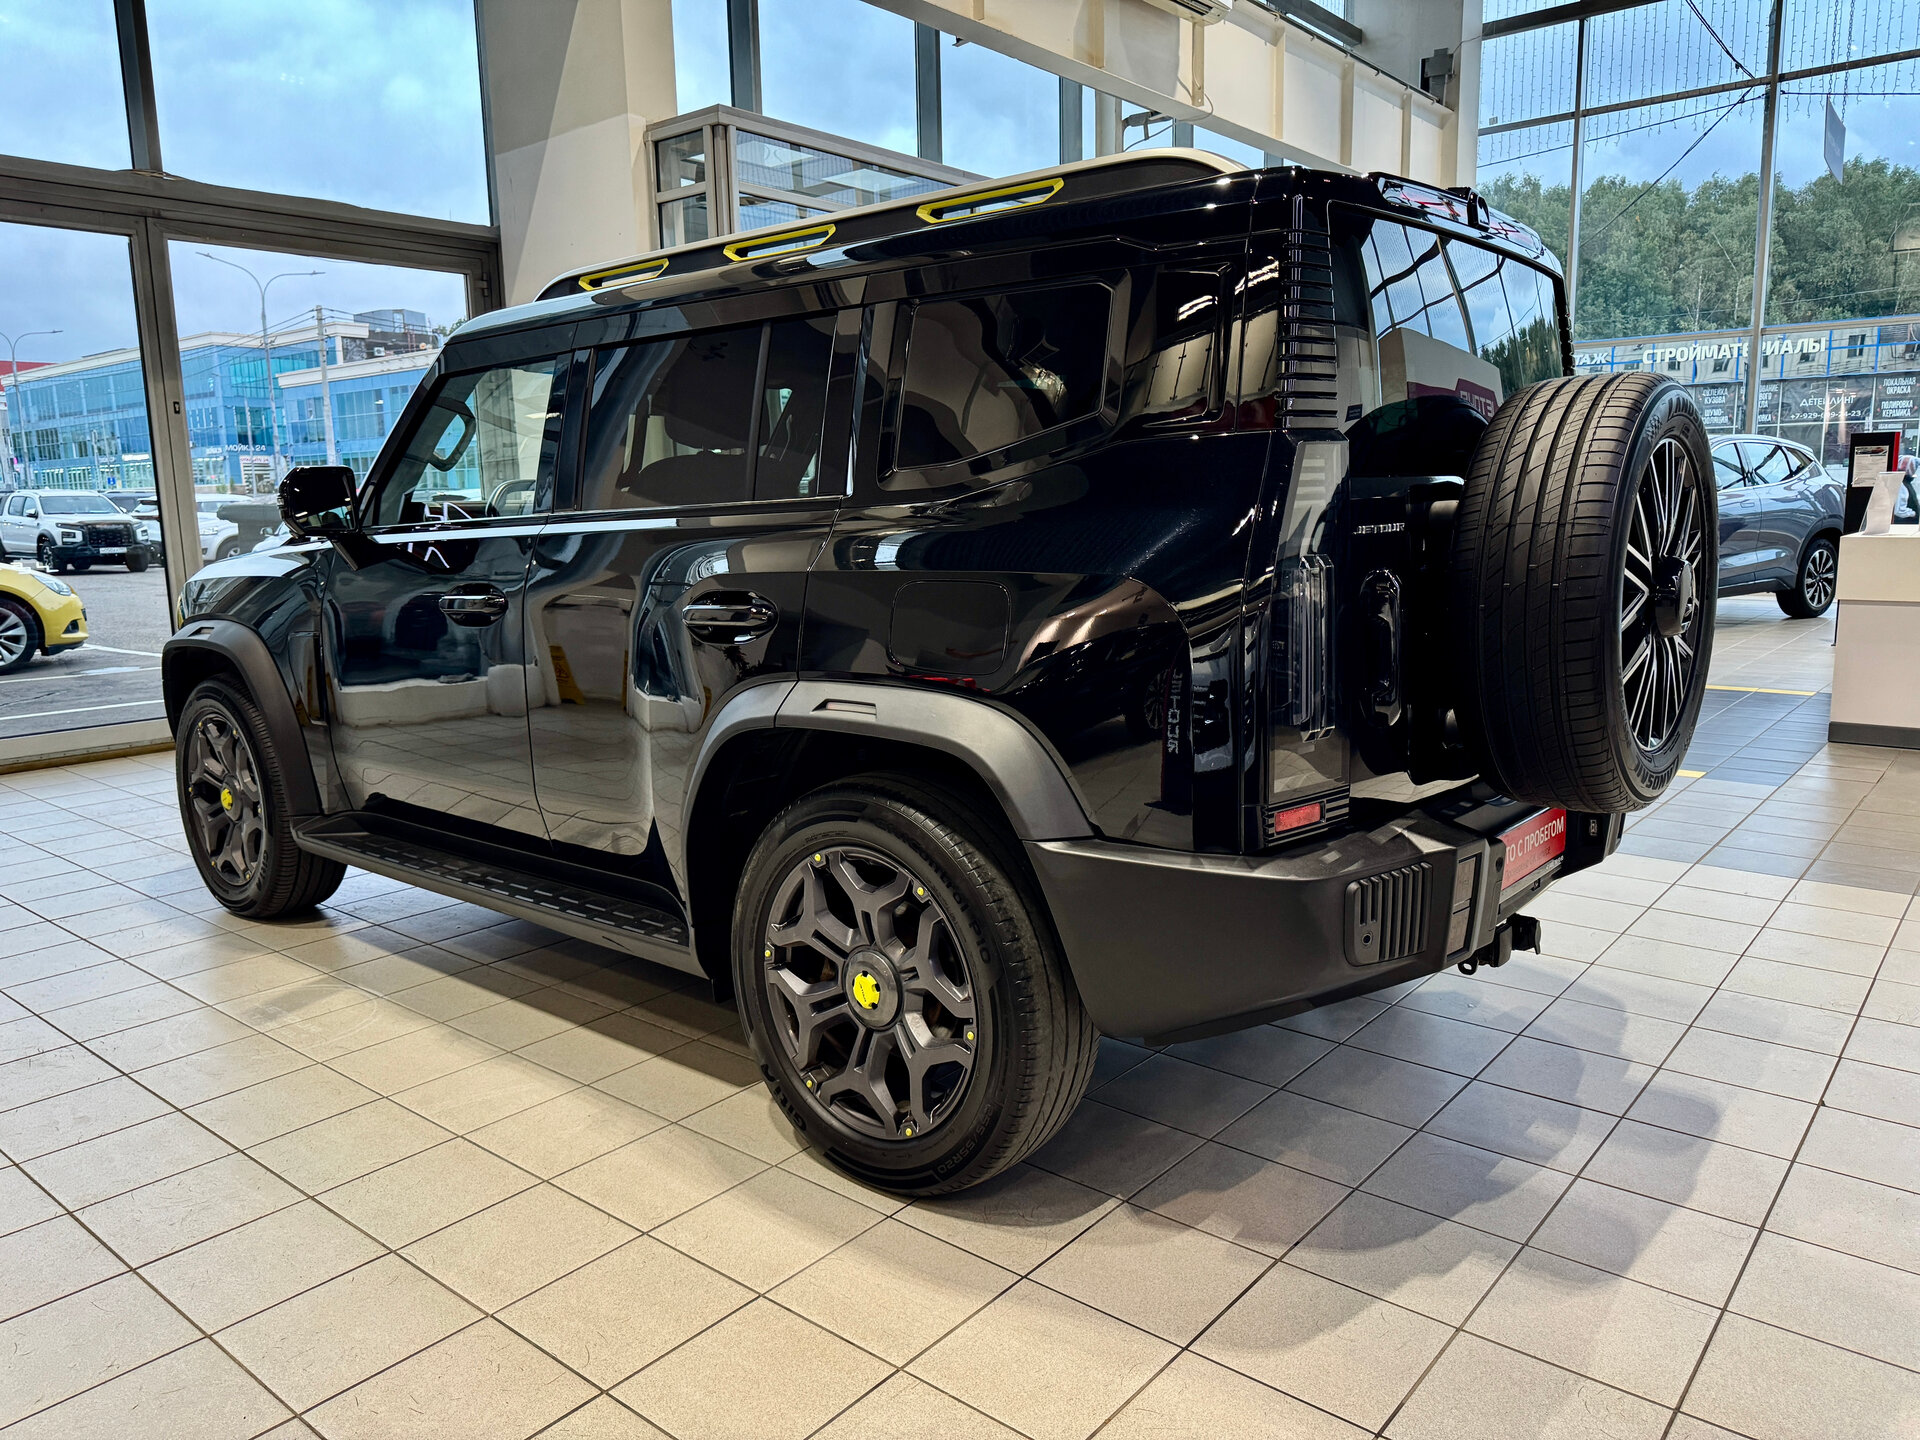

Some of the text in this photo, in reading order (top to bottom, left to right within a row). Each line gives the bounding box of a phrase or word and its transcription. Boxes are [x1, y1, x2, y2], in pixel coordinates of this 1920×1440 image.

[1886, 386, 1911, 395] ОКРАСКА
[1704, 396, 1726, 405] КУЗОВА
[1881, 400, 1913, 410] ПОЛИРОВКА
[1882, 409, 1911, 418] КЕРАМИКА
[1352, 522, 1405, 534] JETOUR
[1517, 840, 1523, 857] С
[1524, 815, 1565, 854] ПРОБЕГОМ
